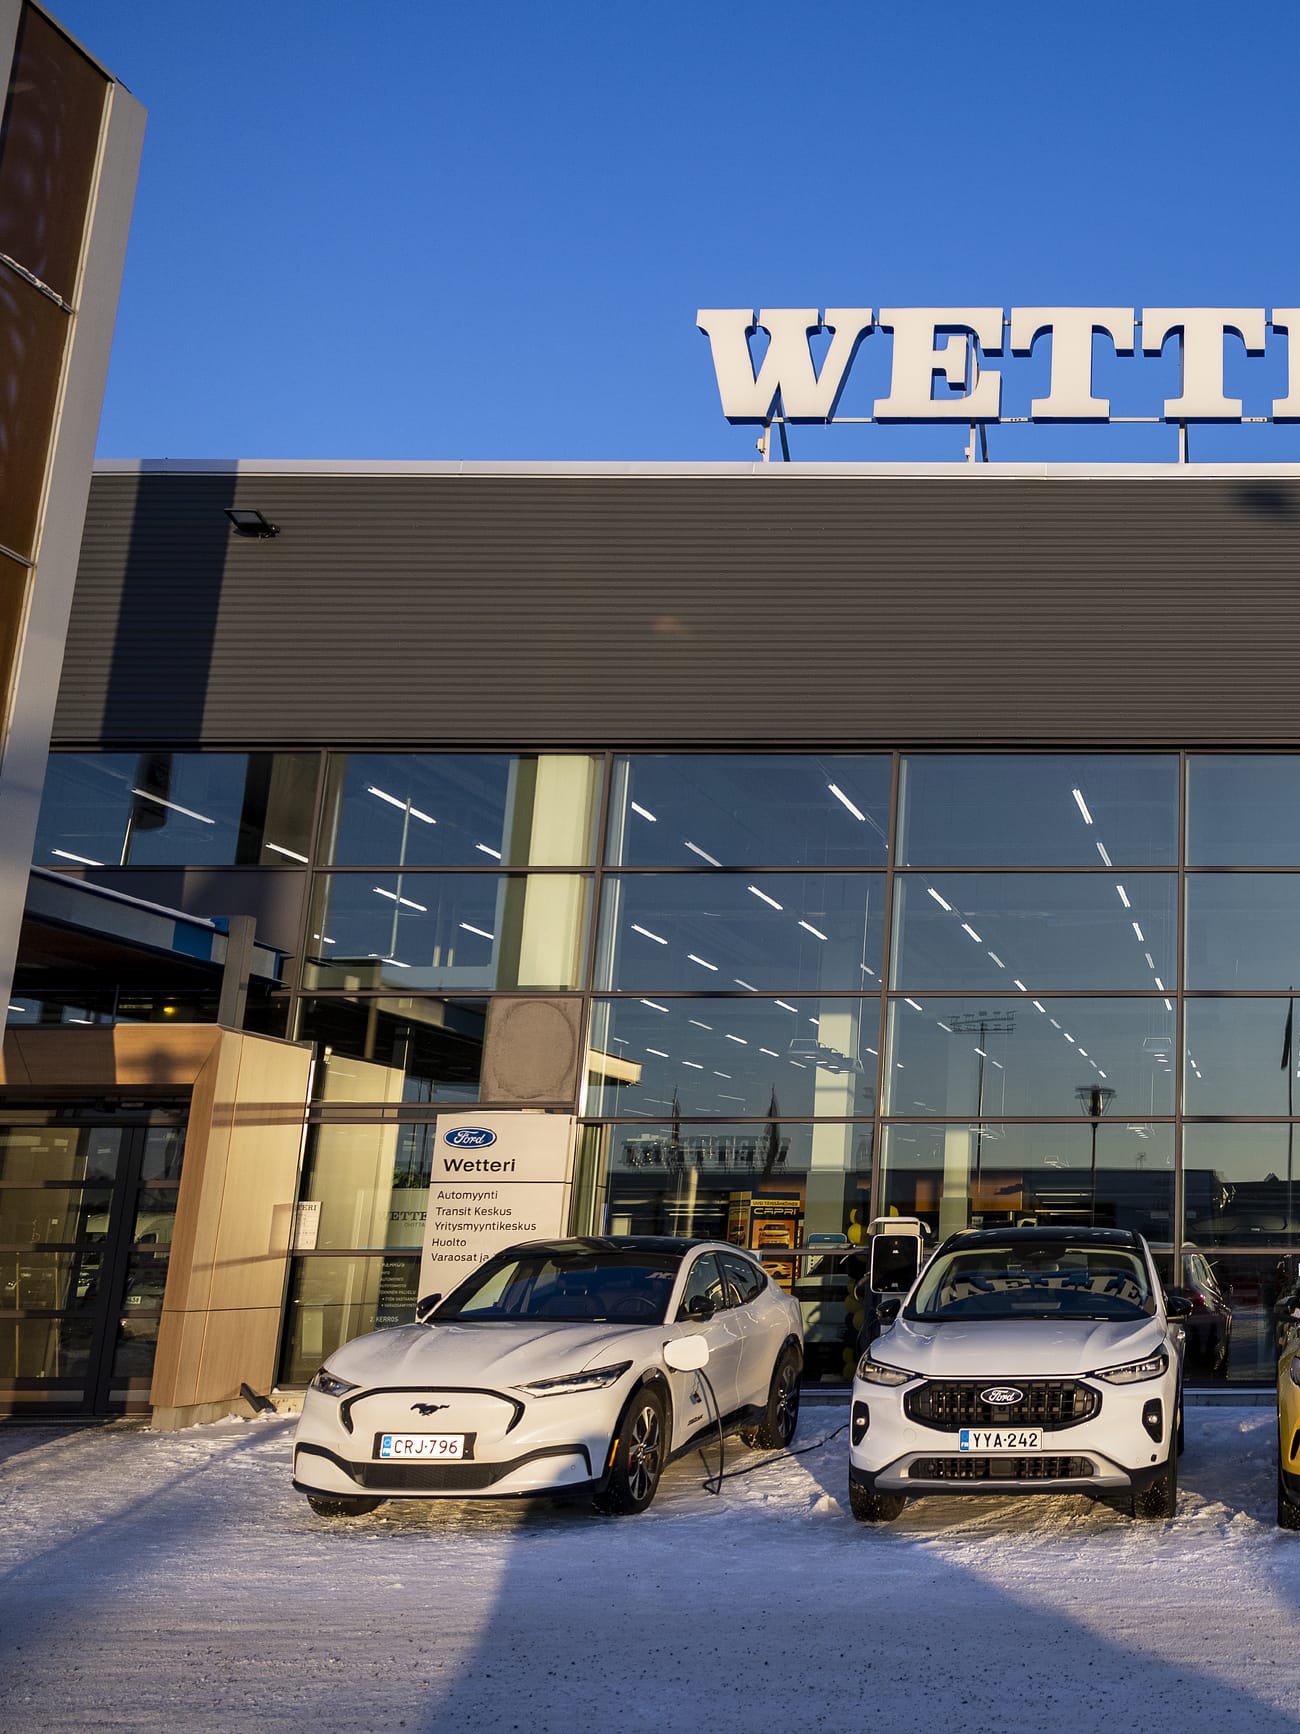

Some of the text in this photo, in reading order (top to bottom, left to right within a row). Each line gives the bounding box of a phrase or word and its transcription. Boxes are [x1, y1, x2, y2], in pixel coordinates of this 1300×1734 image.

[453, 1130, 486, 1145] Ford
[443, 1158, 517, 1172] Wetteri
[436, 1190, 499, 1202] Automyynti
[436, 1206, 512, 1216] Transit Keskus
[753, 1207, 797, 1215] CAPRI
[434, 1221, 537, 1232] Yritysmyyntikeskus
[431, 1238, 467, 1247] Huolto
[431, 1252, 490, 1263] Varaosat ja
[988, 1390, 1016, 1402] Ford
[973, 1432, 1038, 1448] YYA-242
[394, 1439, 458, 1454] CRJ-796
